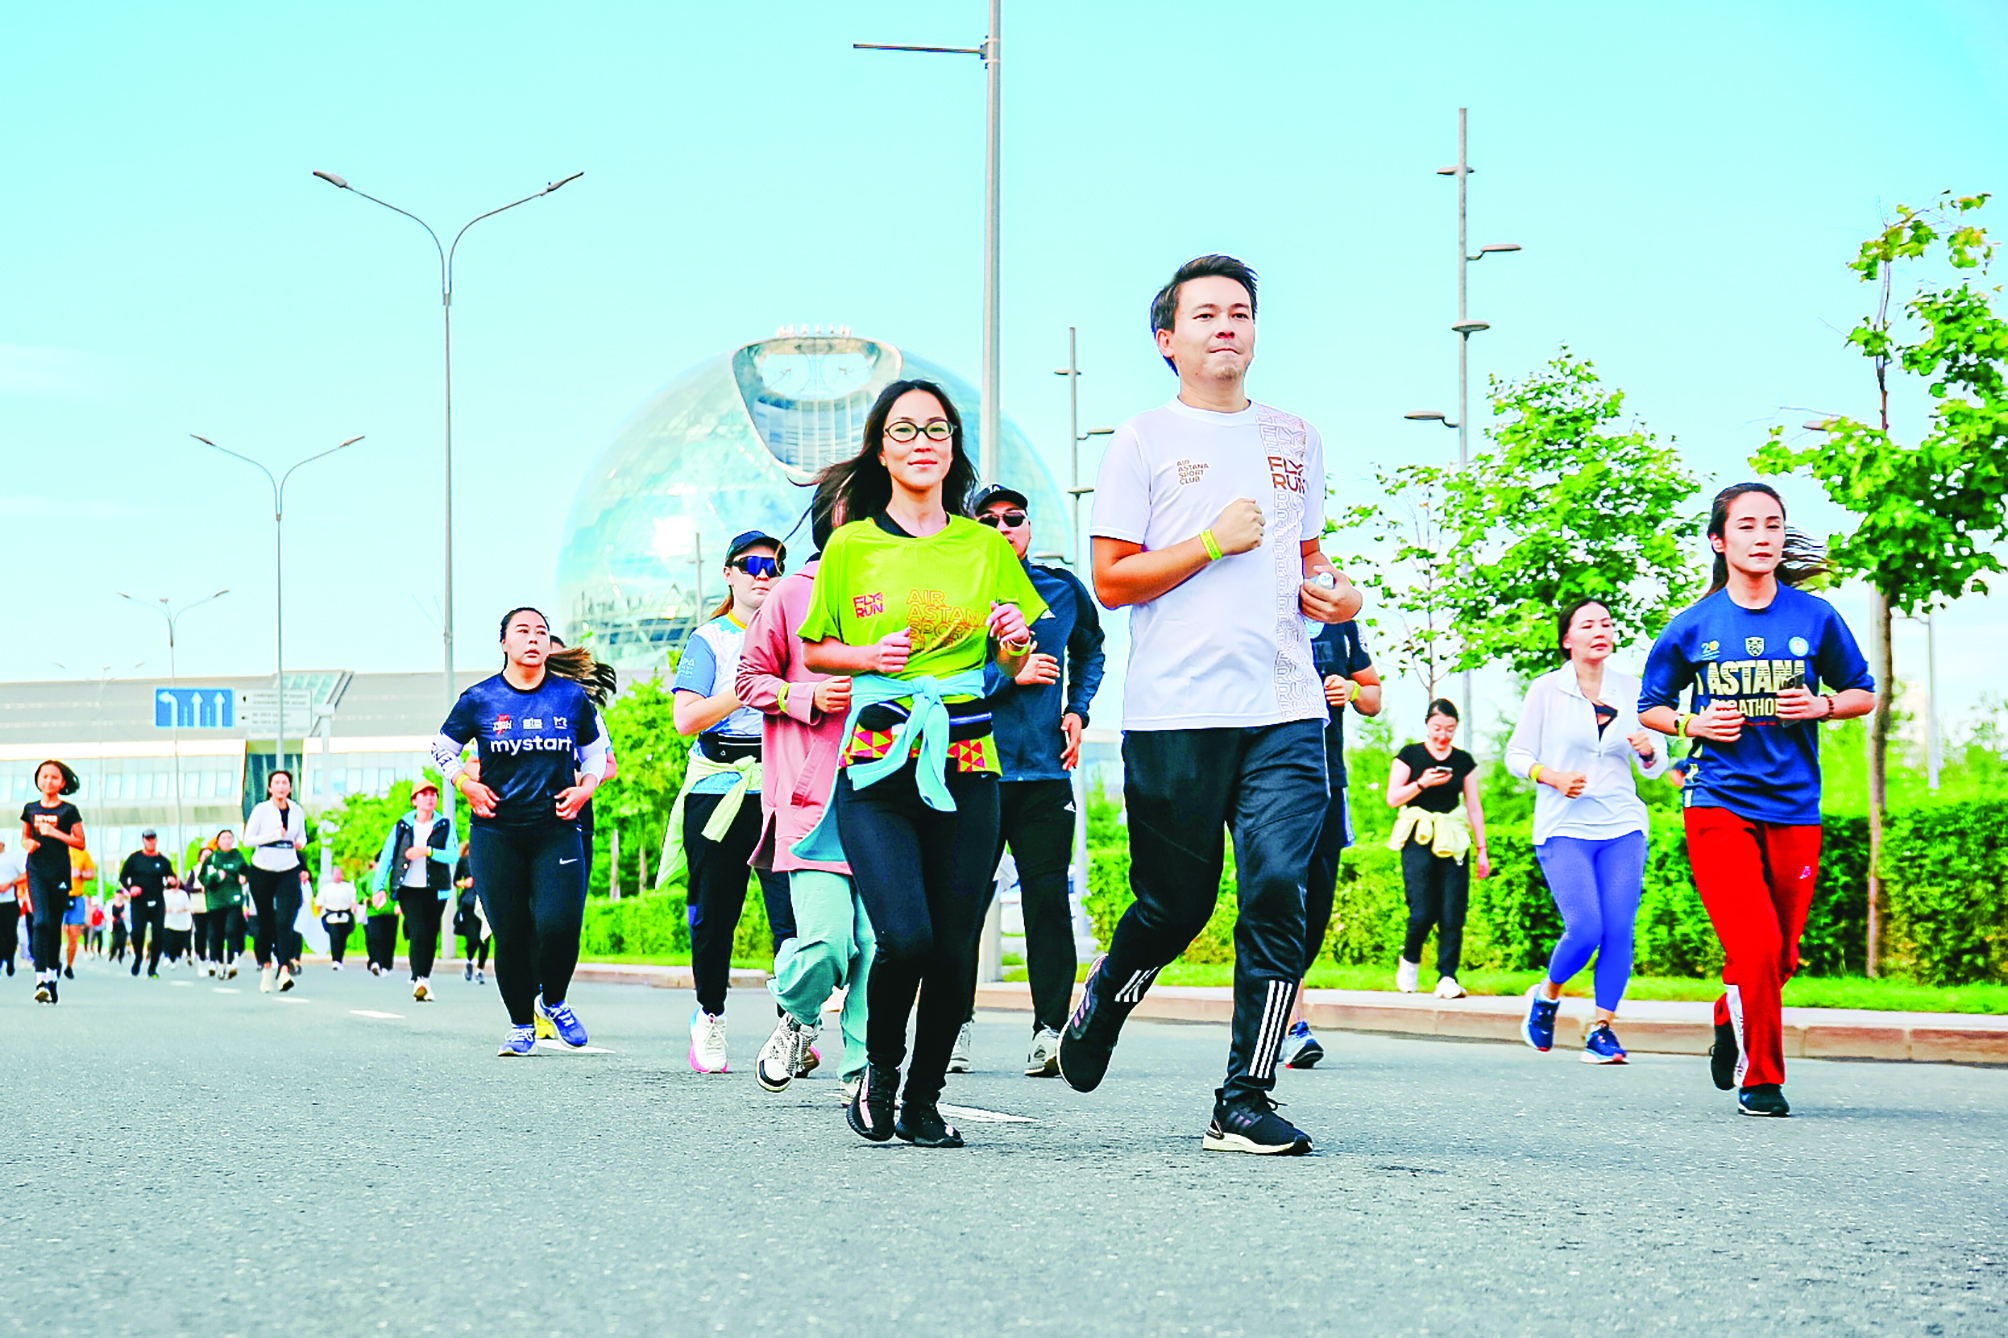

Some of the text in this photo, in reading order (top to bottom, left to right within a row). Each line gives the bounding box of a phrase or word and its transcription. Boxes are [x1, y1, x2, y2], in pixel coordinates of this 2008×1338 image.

[1178, 463, 1209, 472] ASTANA
[1178, 469, 1204, 478] SPORT
[1267, 456, 1304, 476] FLY
[1179, 475, 1201, 485] CLUB
[906, 589, 945, 606] AIR
[855, 603, 884, 618] RUN
[490, 735, 572, 756] mystart
